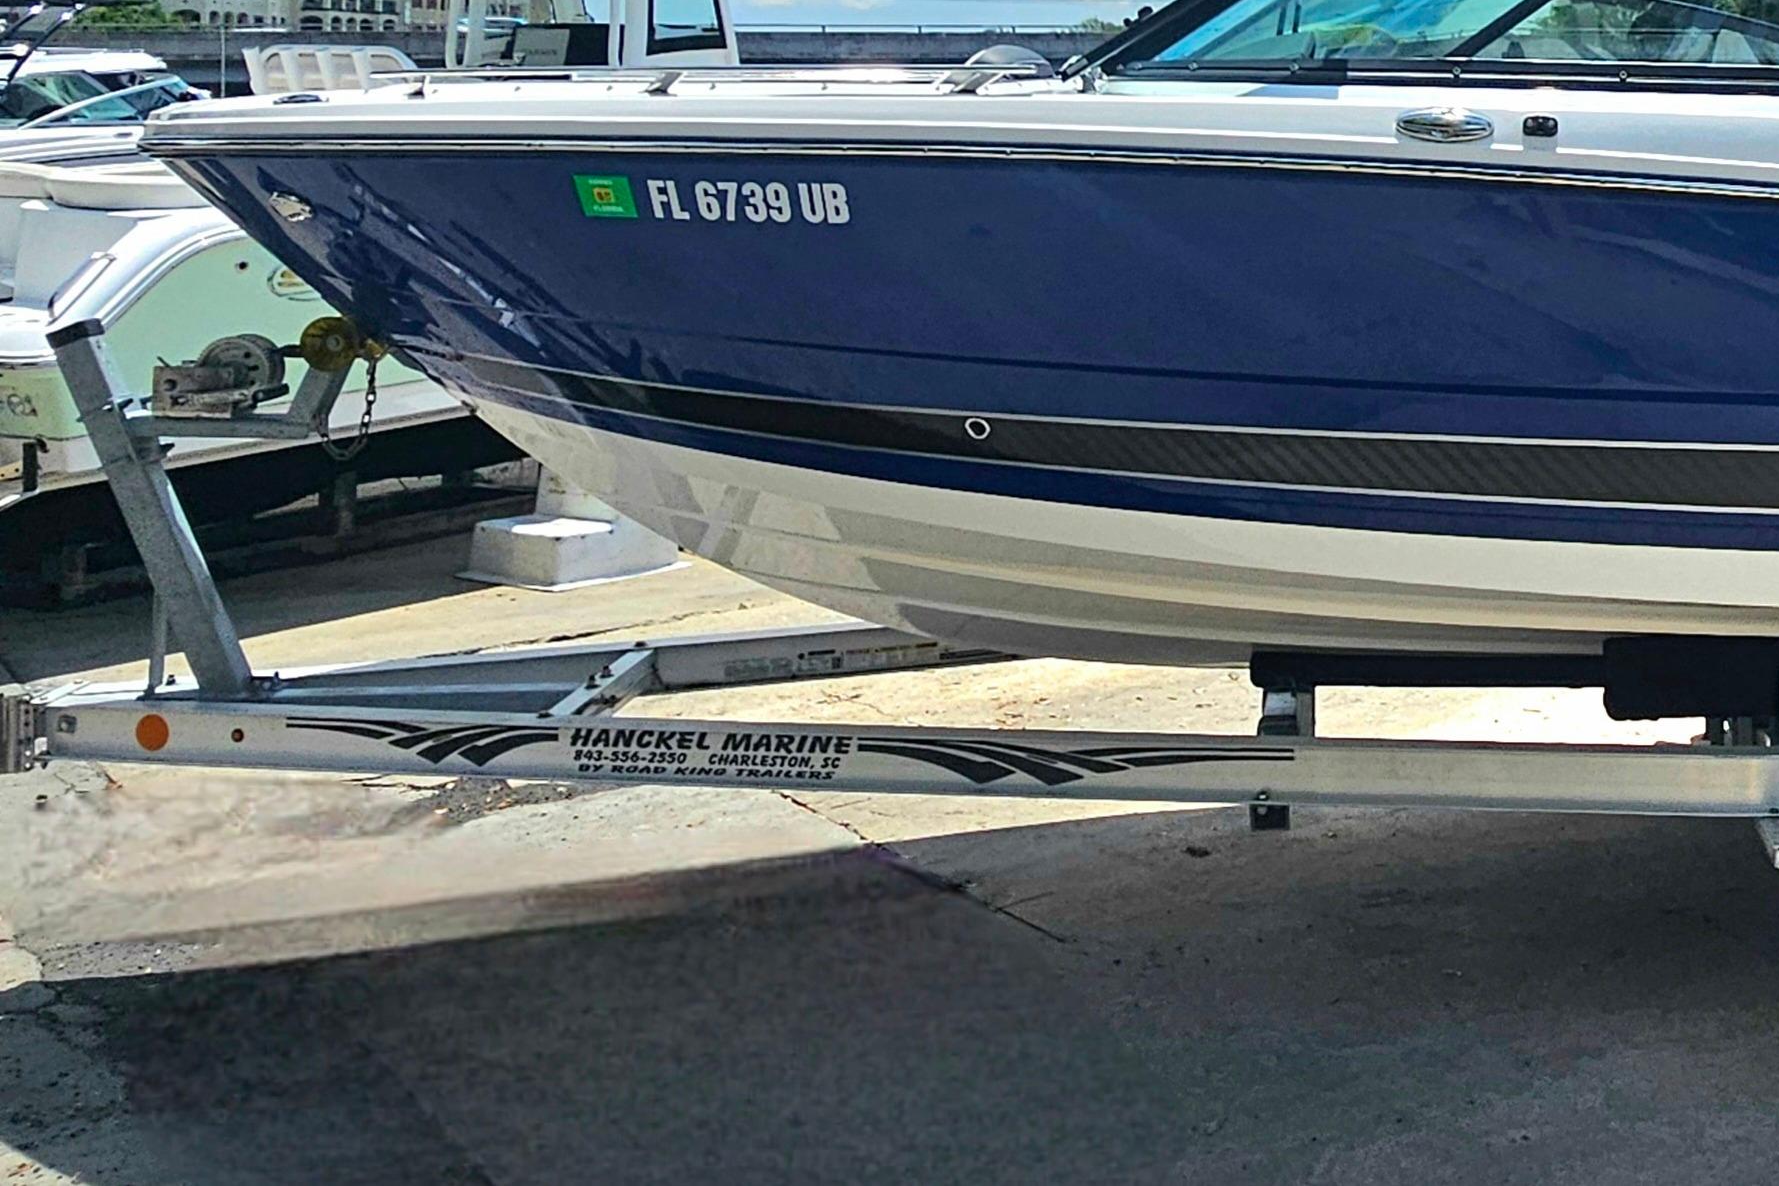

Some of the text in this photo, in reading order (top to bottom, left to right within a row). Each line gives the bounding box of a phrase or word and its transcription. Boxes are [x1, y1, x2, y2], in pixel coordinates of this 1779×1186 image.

[646, 179, 850, 224] FL 6739 UB
[569, 727, 854, 755] HANCKEL MARINE
[573, 749, 841, 770] 843-556-2550 CHARLESTON, SC
[577, 763, 837, 781] BY ROAD KING TRAILERS
